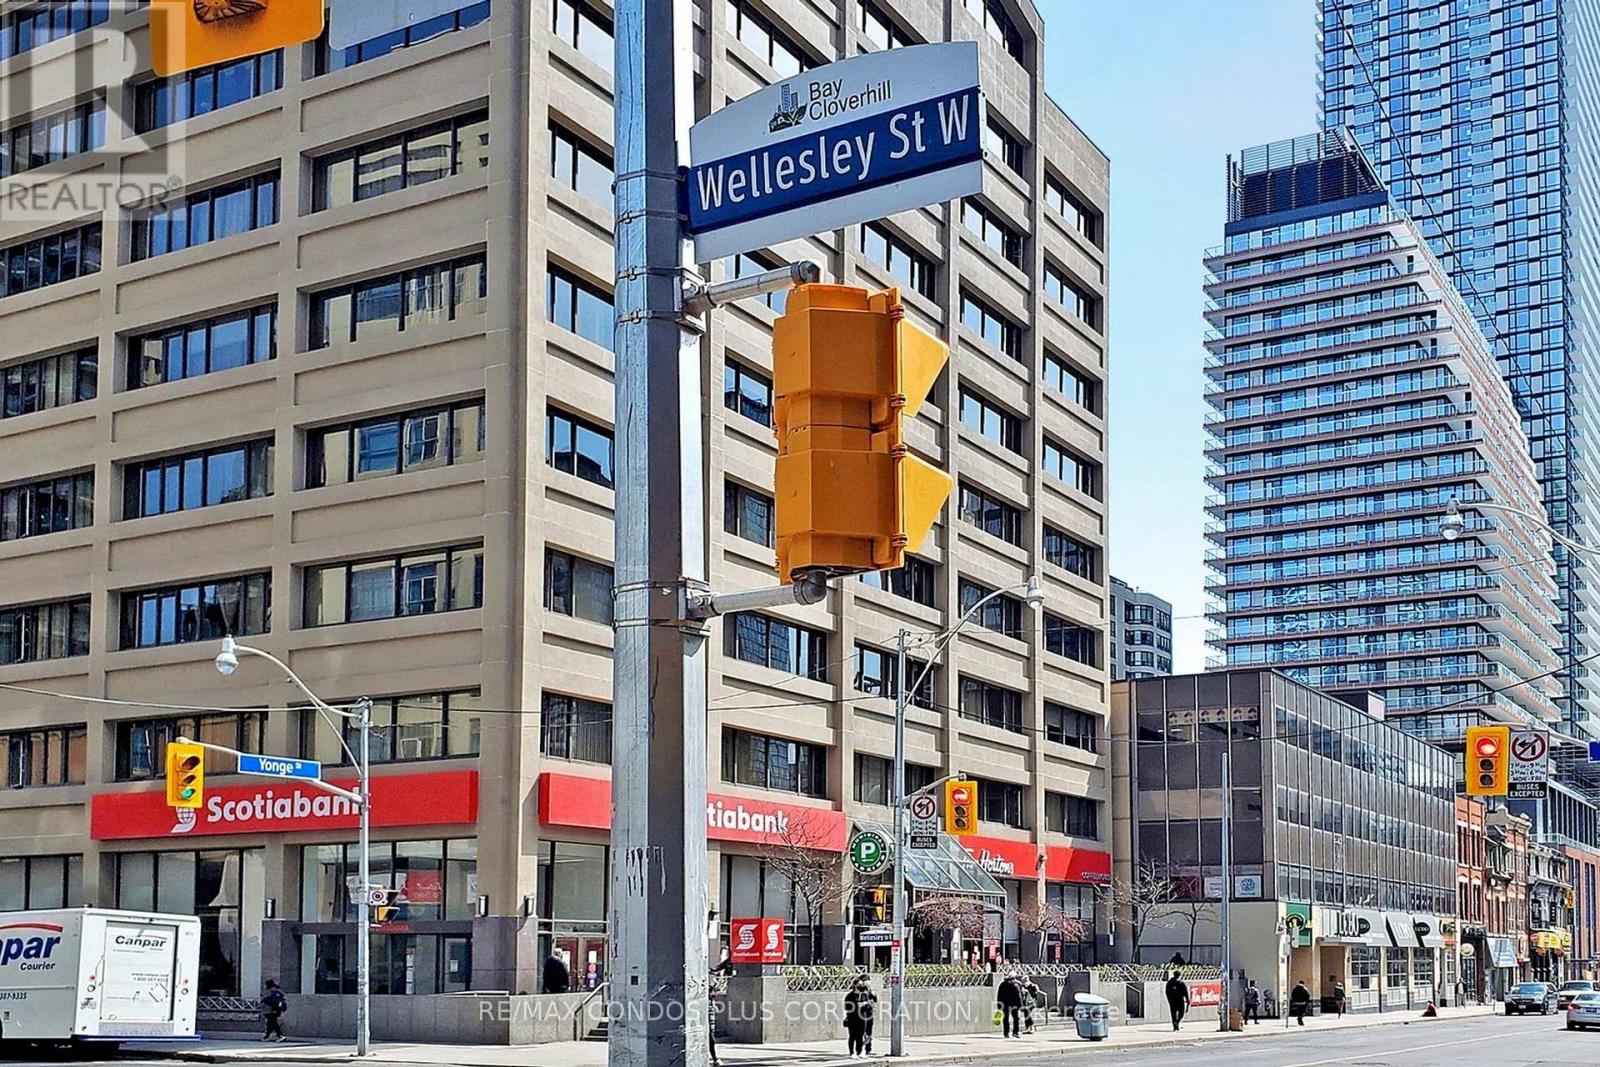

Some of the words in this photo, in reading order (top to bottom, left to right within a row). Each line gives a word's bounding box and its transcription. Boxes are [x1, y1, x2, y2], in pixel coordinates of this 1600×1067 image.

[809, 78, 843, 101] Bay
[809, 80, 891, 121] Cloverhill
[697, 131, 875, 211] Wellesley
[889, 111, 926, 160] St
[937, 94, 969, 145] W
[259, 758, 293, 775] Yonge
[861, 842, 875, 858] P
[115, 935, 167, 947] Canpar
[20, 962, 56, 970] Courier
